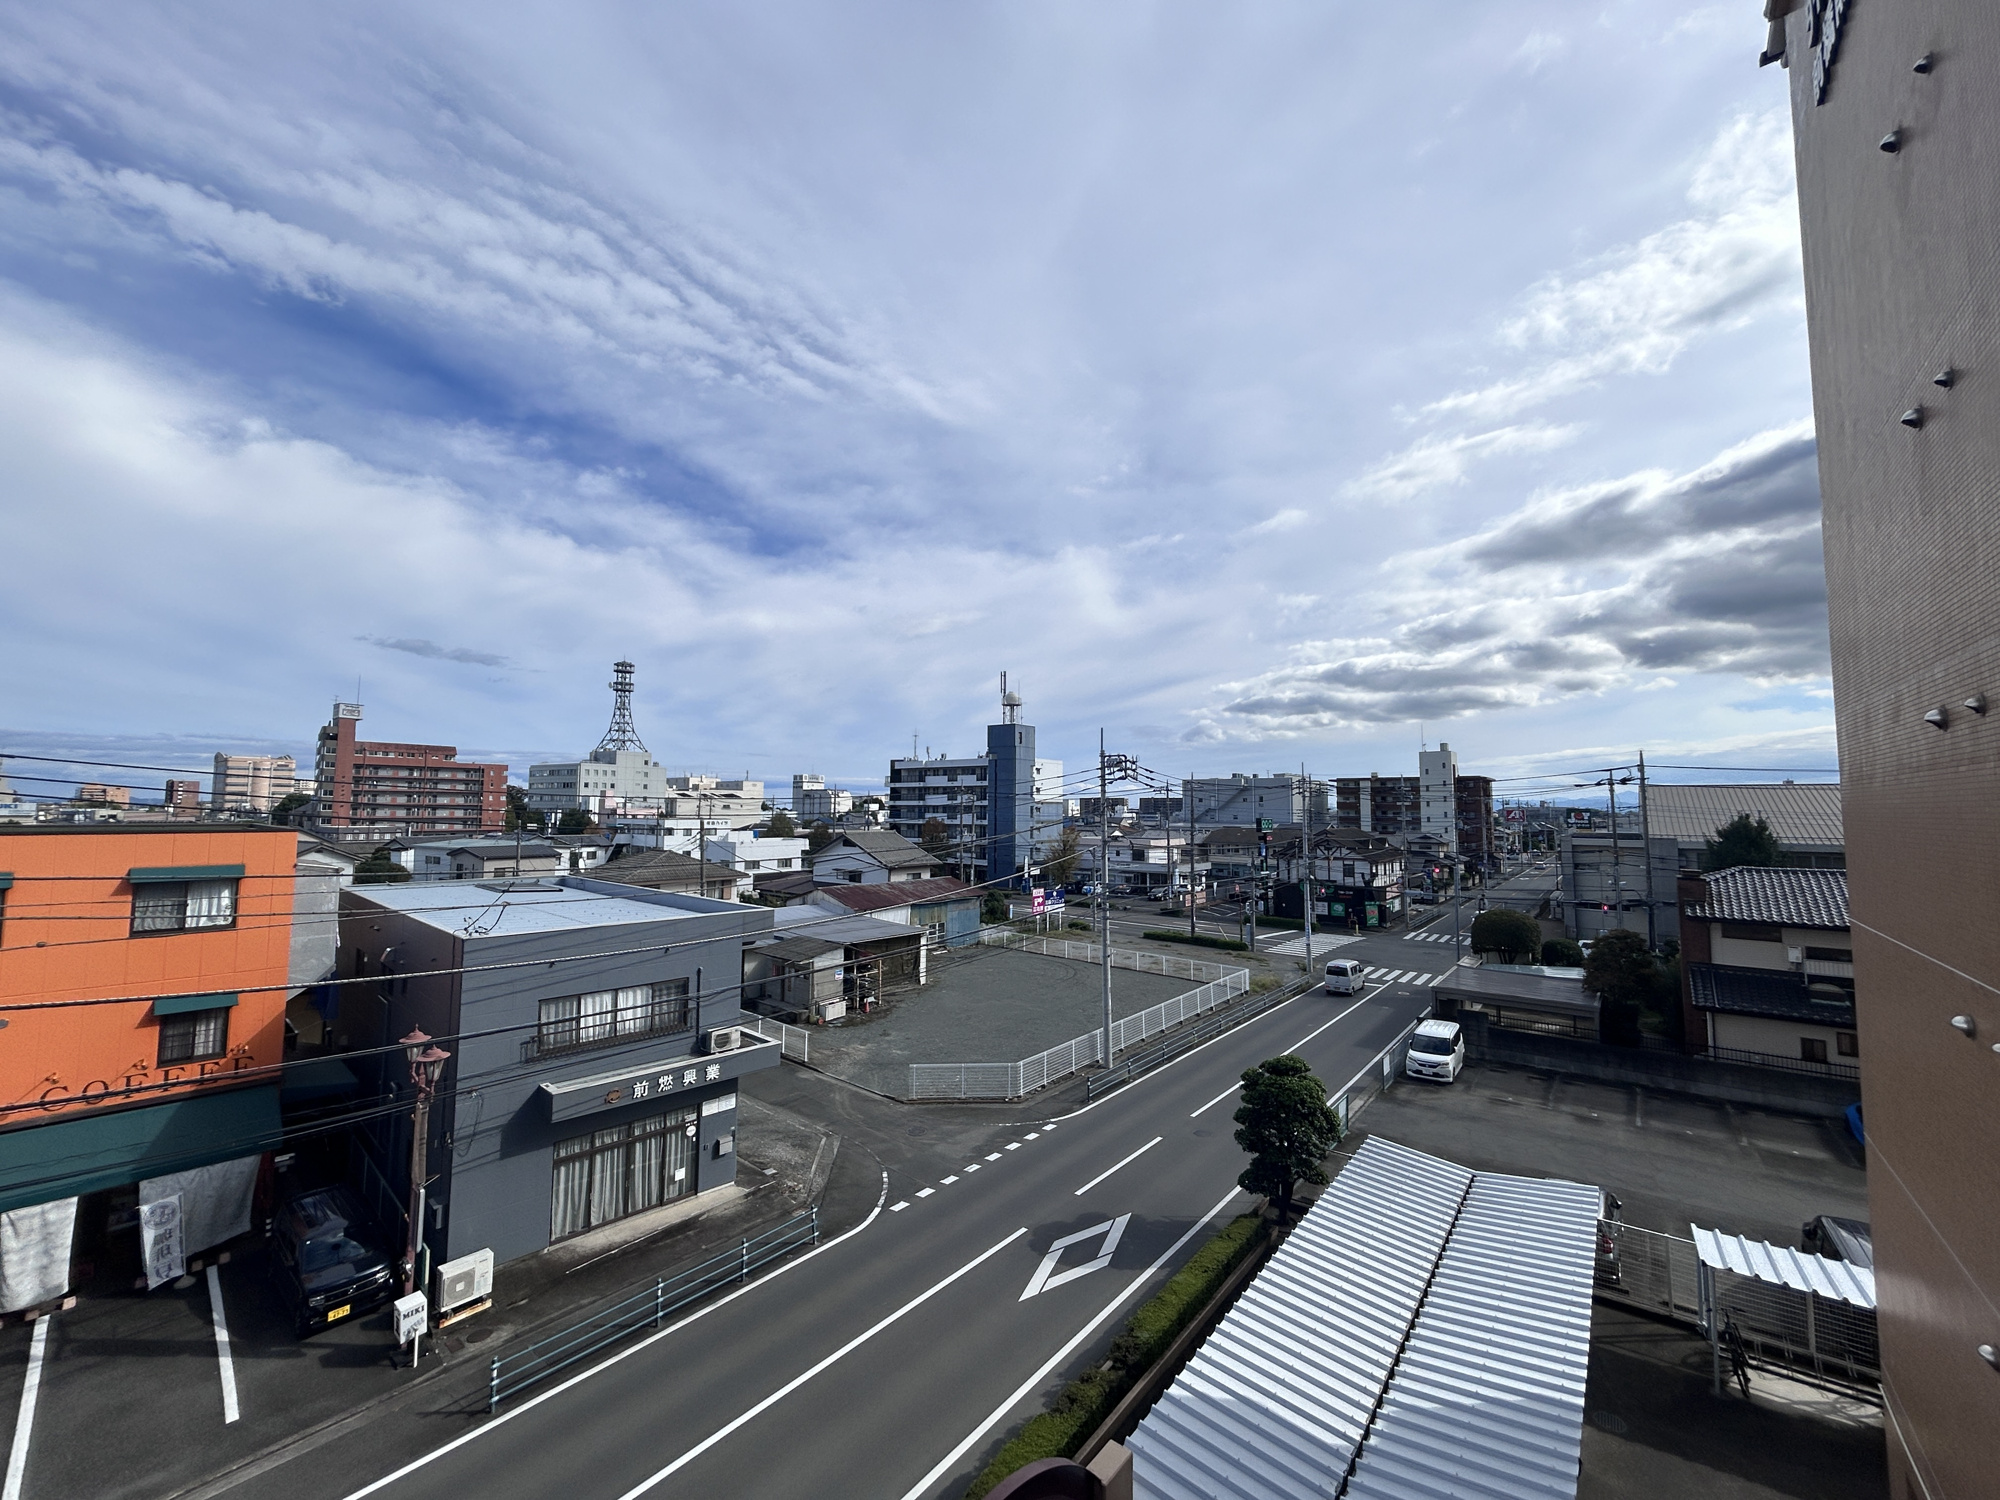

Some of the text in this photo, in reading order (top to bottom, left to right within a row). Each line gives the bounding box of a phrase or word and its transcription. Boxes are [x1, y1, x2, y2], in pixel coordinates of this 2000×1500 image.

[39, 1056, 254, 1111] COFFEE
[632, 1064, 720, 1098] 前燃興業
[402, 1304, 425, 1320] MIKI
